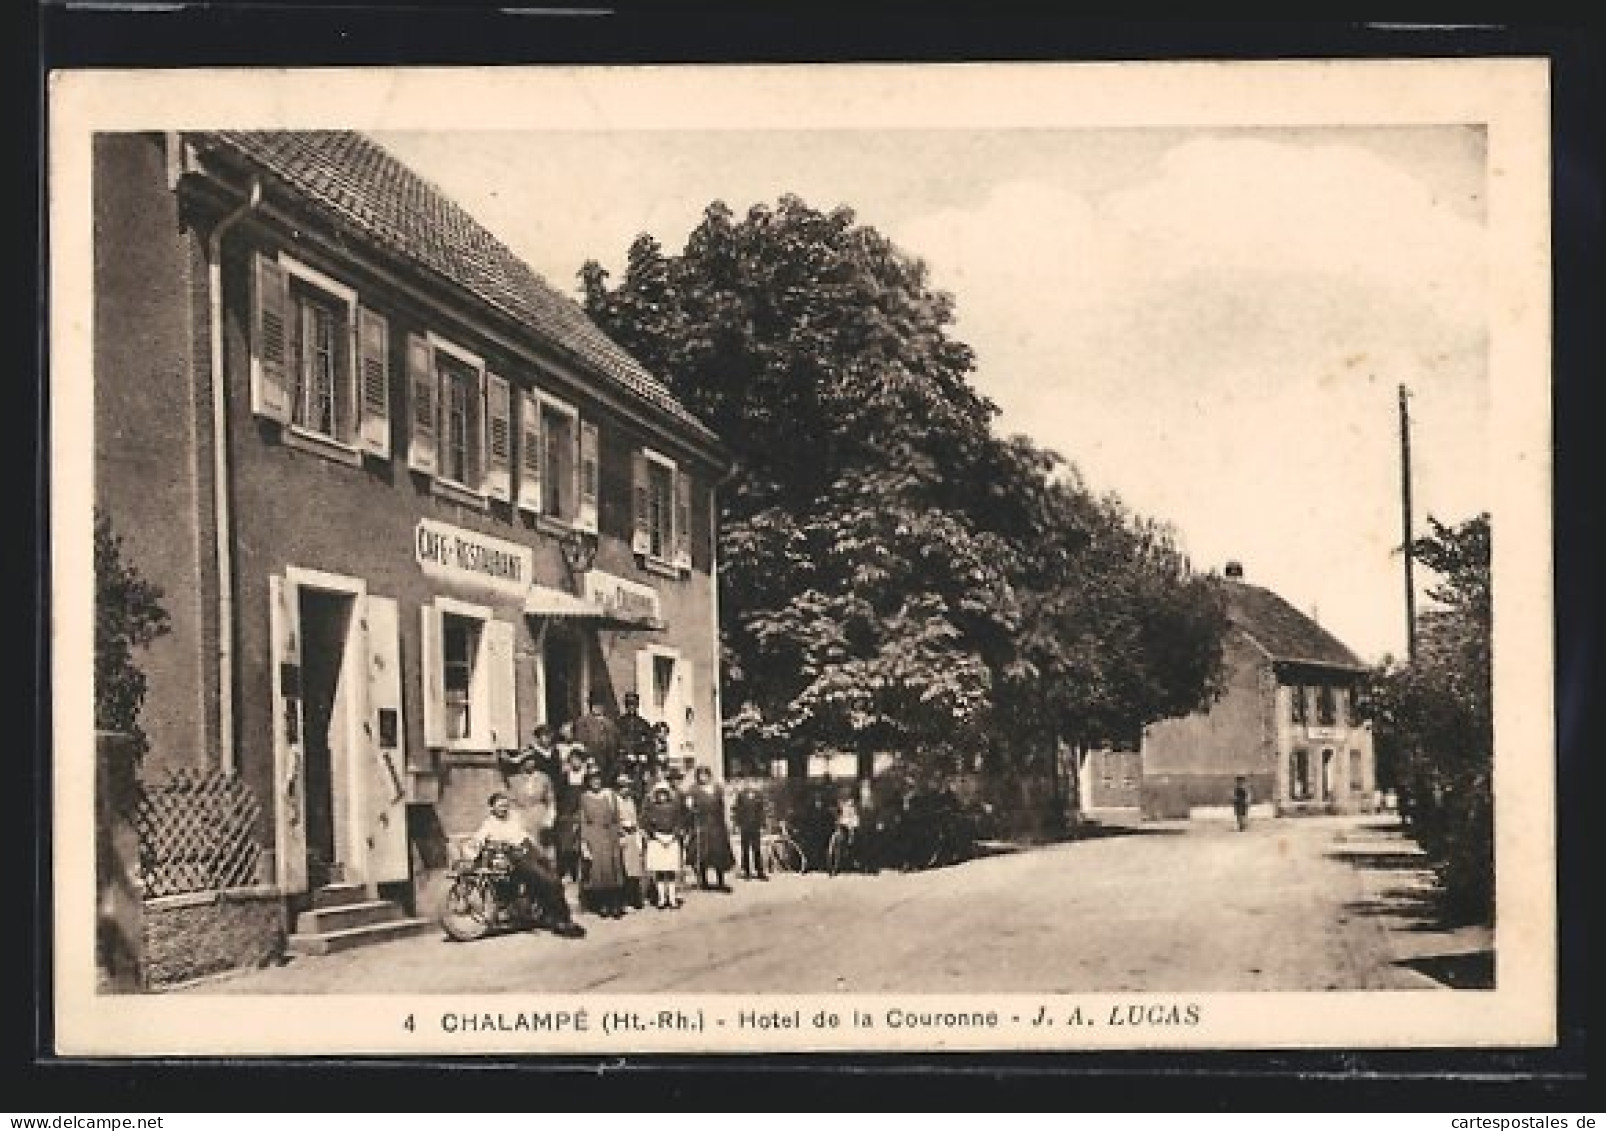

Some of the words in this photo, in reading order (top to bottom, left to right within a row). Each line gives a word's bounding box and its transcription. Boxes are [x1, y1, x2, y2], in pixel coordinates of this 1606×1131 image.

[404, 1013, 415, 1033] 4
[440, 1008, 589, 1034] CHALAMPÉ
[602, 1010, 704, 1036] (Ht.-Rh.)
[738, 1010, 800, 1031] Hotel
[812, 1010, 841, 1029] de
[853, 1010, 874, 1028] la
[886, 1009, 999, 1029] Couronne
[1032, 1005, 1054, 1026] J.
[1067, 1006, 1095, 1026] A.
[1108, 1004, 1202, 1026] LUCAS
